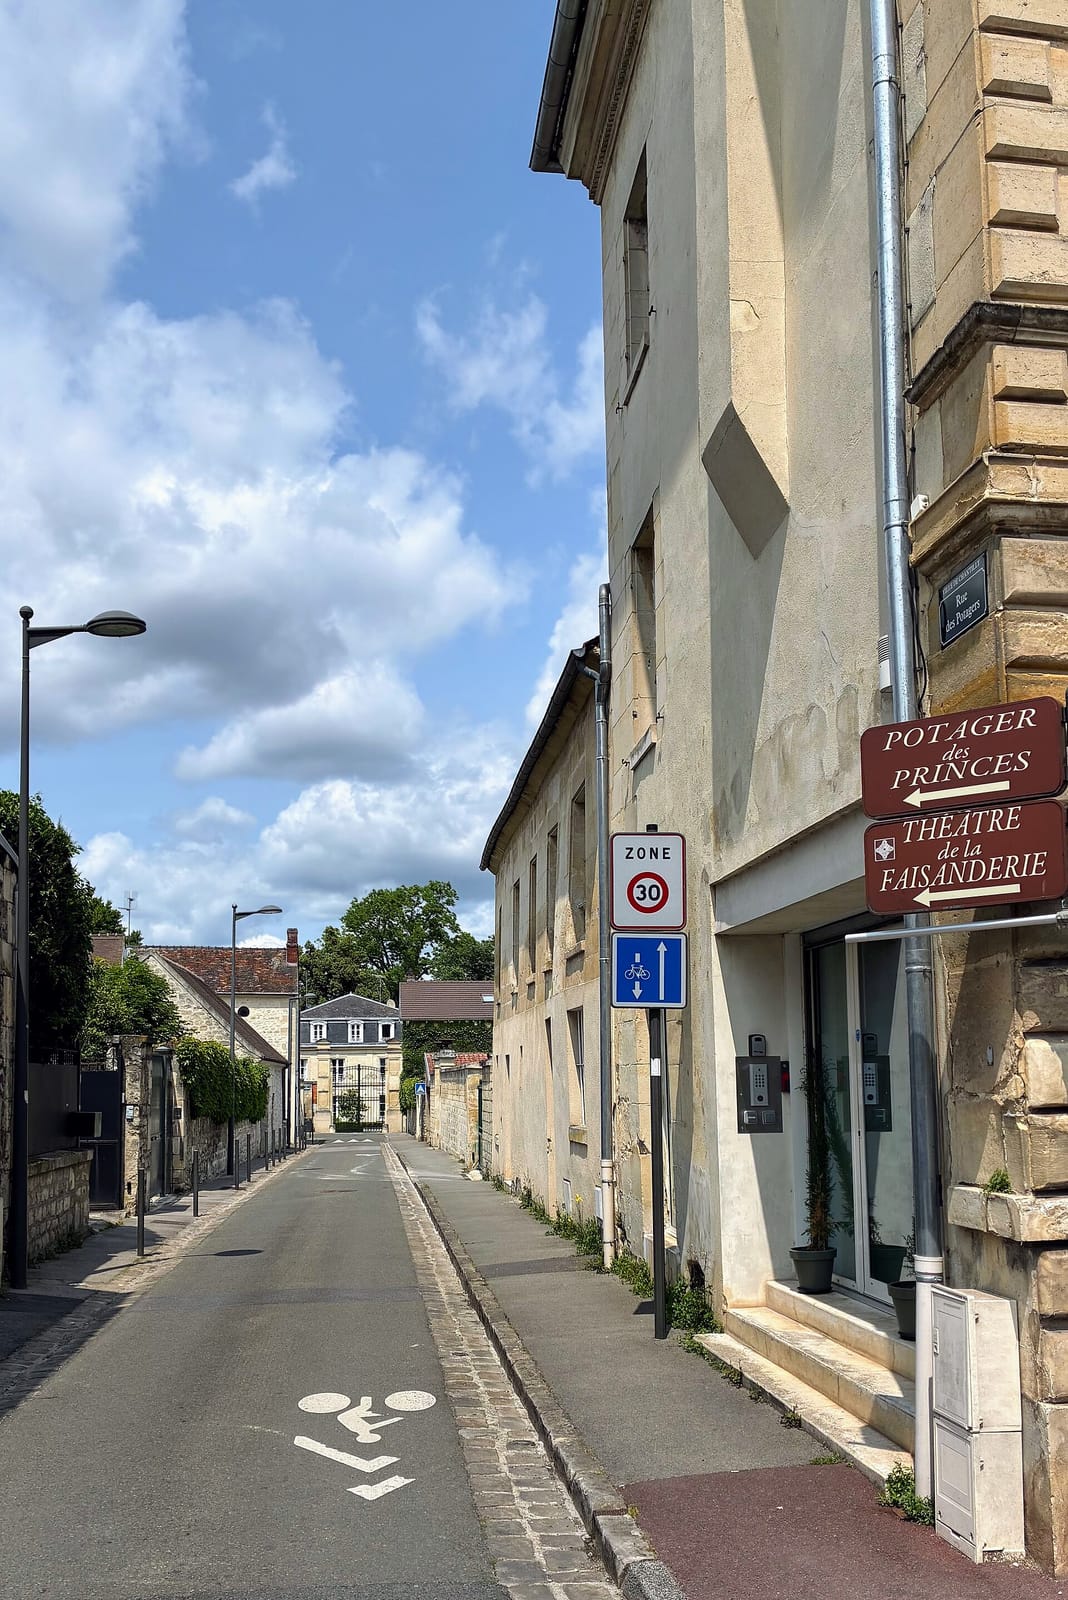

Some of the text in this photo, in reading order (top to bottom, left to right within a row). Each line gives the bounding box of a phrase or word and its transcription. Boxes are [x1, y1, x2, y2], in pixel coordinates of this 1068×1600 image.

[956, 592, 967, 608] Rue
[946, 600, 980, 633] des Potagers
[883, 708, 1037, 751] POTAGER
[942, 744, 970, 761] des
[890, 751, 1031, 790] PRINCES
[625, 847, 671, 860] ZONE
[937, 840, 982, 860] de la
[879, 852, 1047, 892] FAISANDERIE
[635, 884, 661, 901] 30
